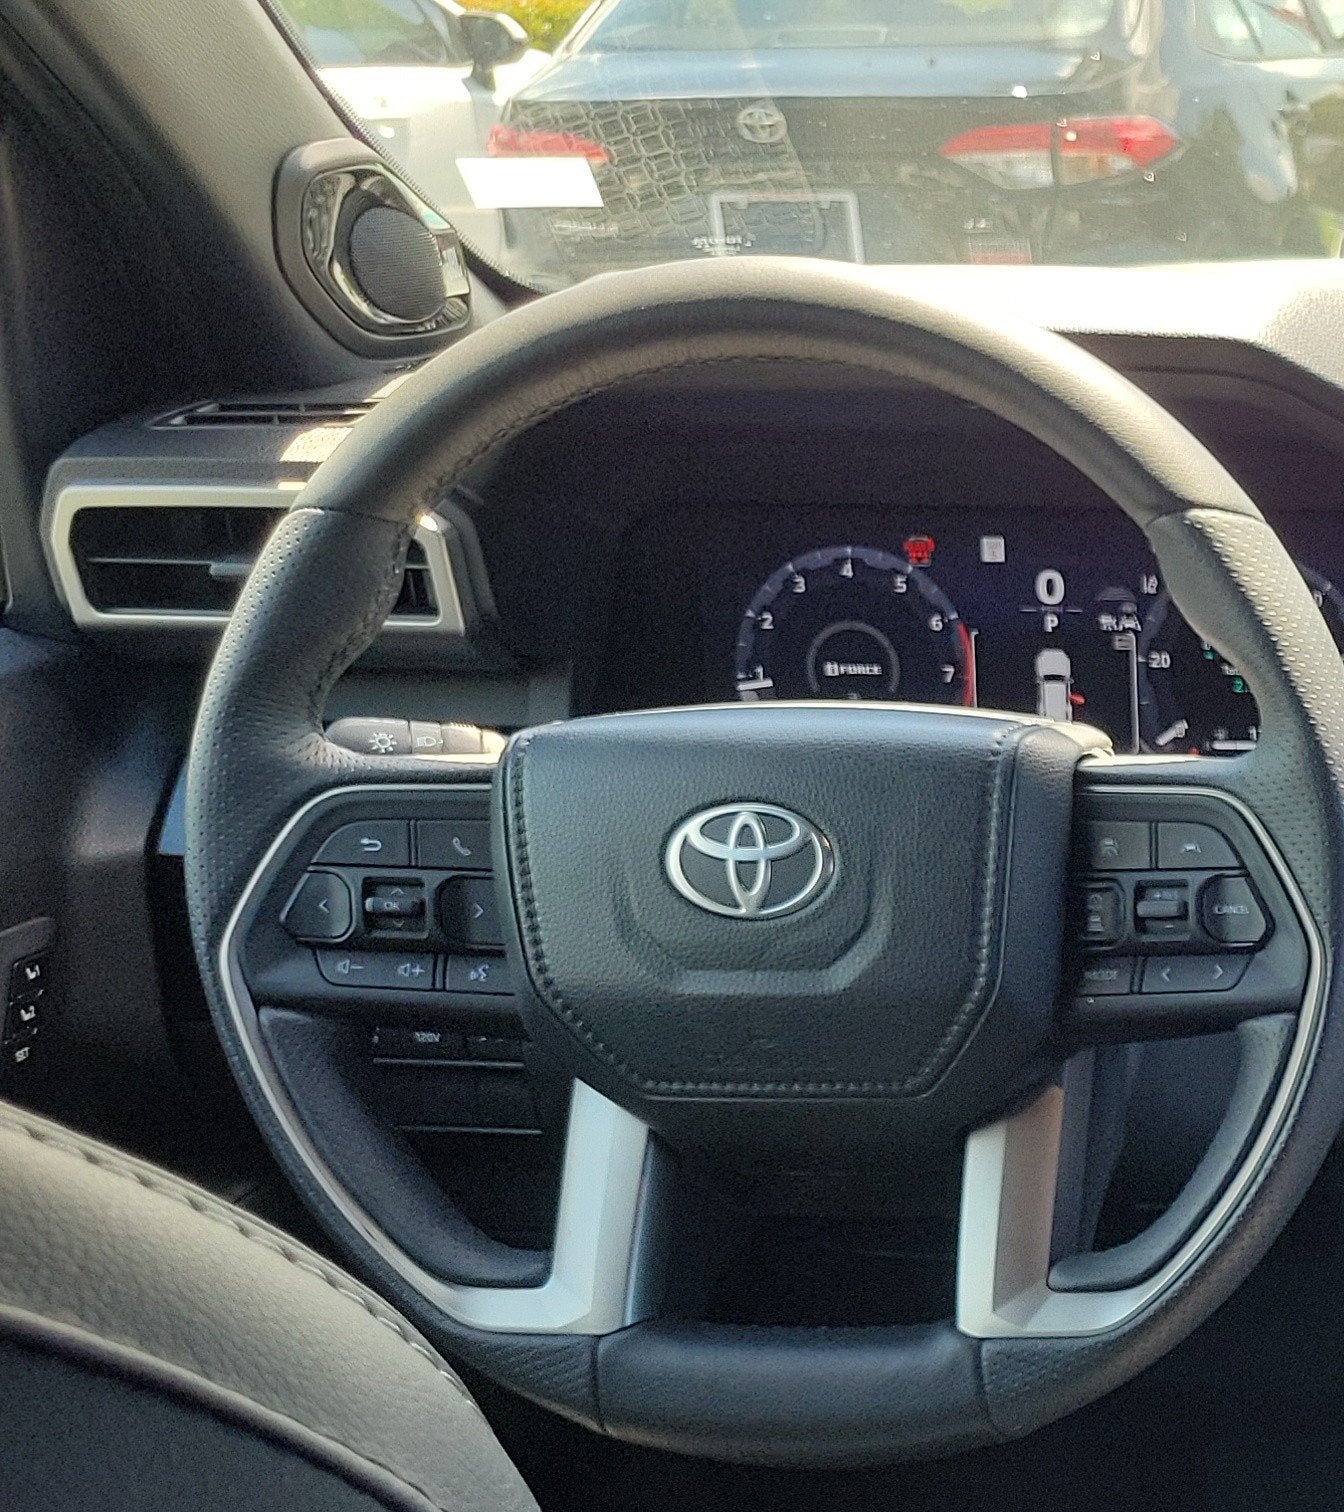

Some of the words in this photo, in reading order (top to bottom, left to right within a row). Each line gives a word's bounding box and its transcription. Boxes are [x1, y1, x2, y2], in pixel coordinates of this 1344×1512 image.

[839, 561, 854, 579] 4
[792, 574, 806, 594] 3
[893, 575, 907, 594] 5
[1034, 568, 1066, 606] 0
[759, 611, 774, 630] 2
[928, 612, 943, 632] 6
[1043, 613, 1060, 633] P
[1148, 650, 1171, 669] 20
[941, 664, 955, 684] 7
